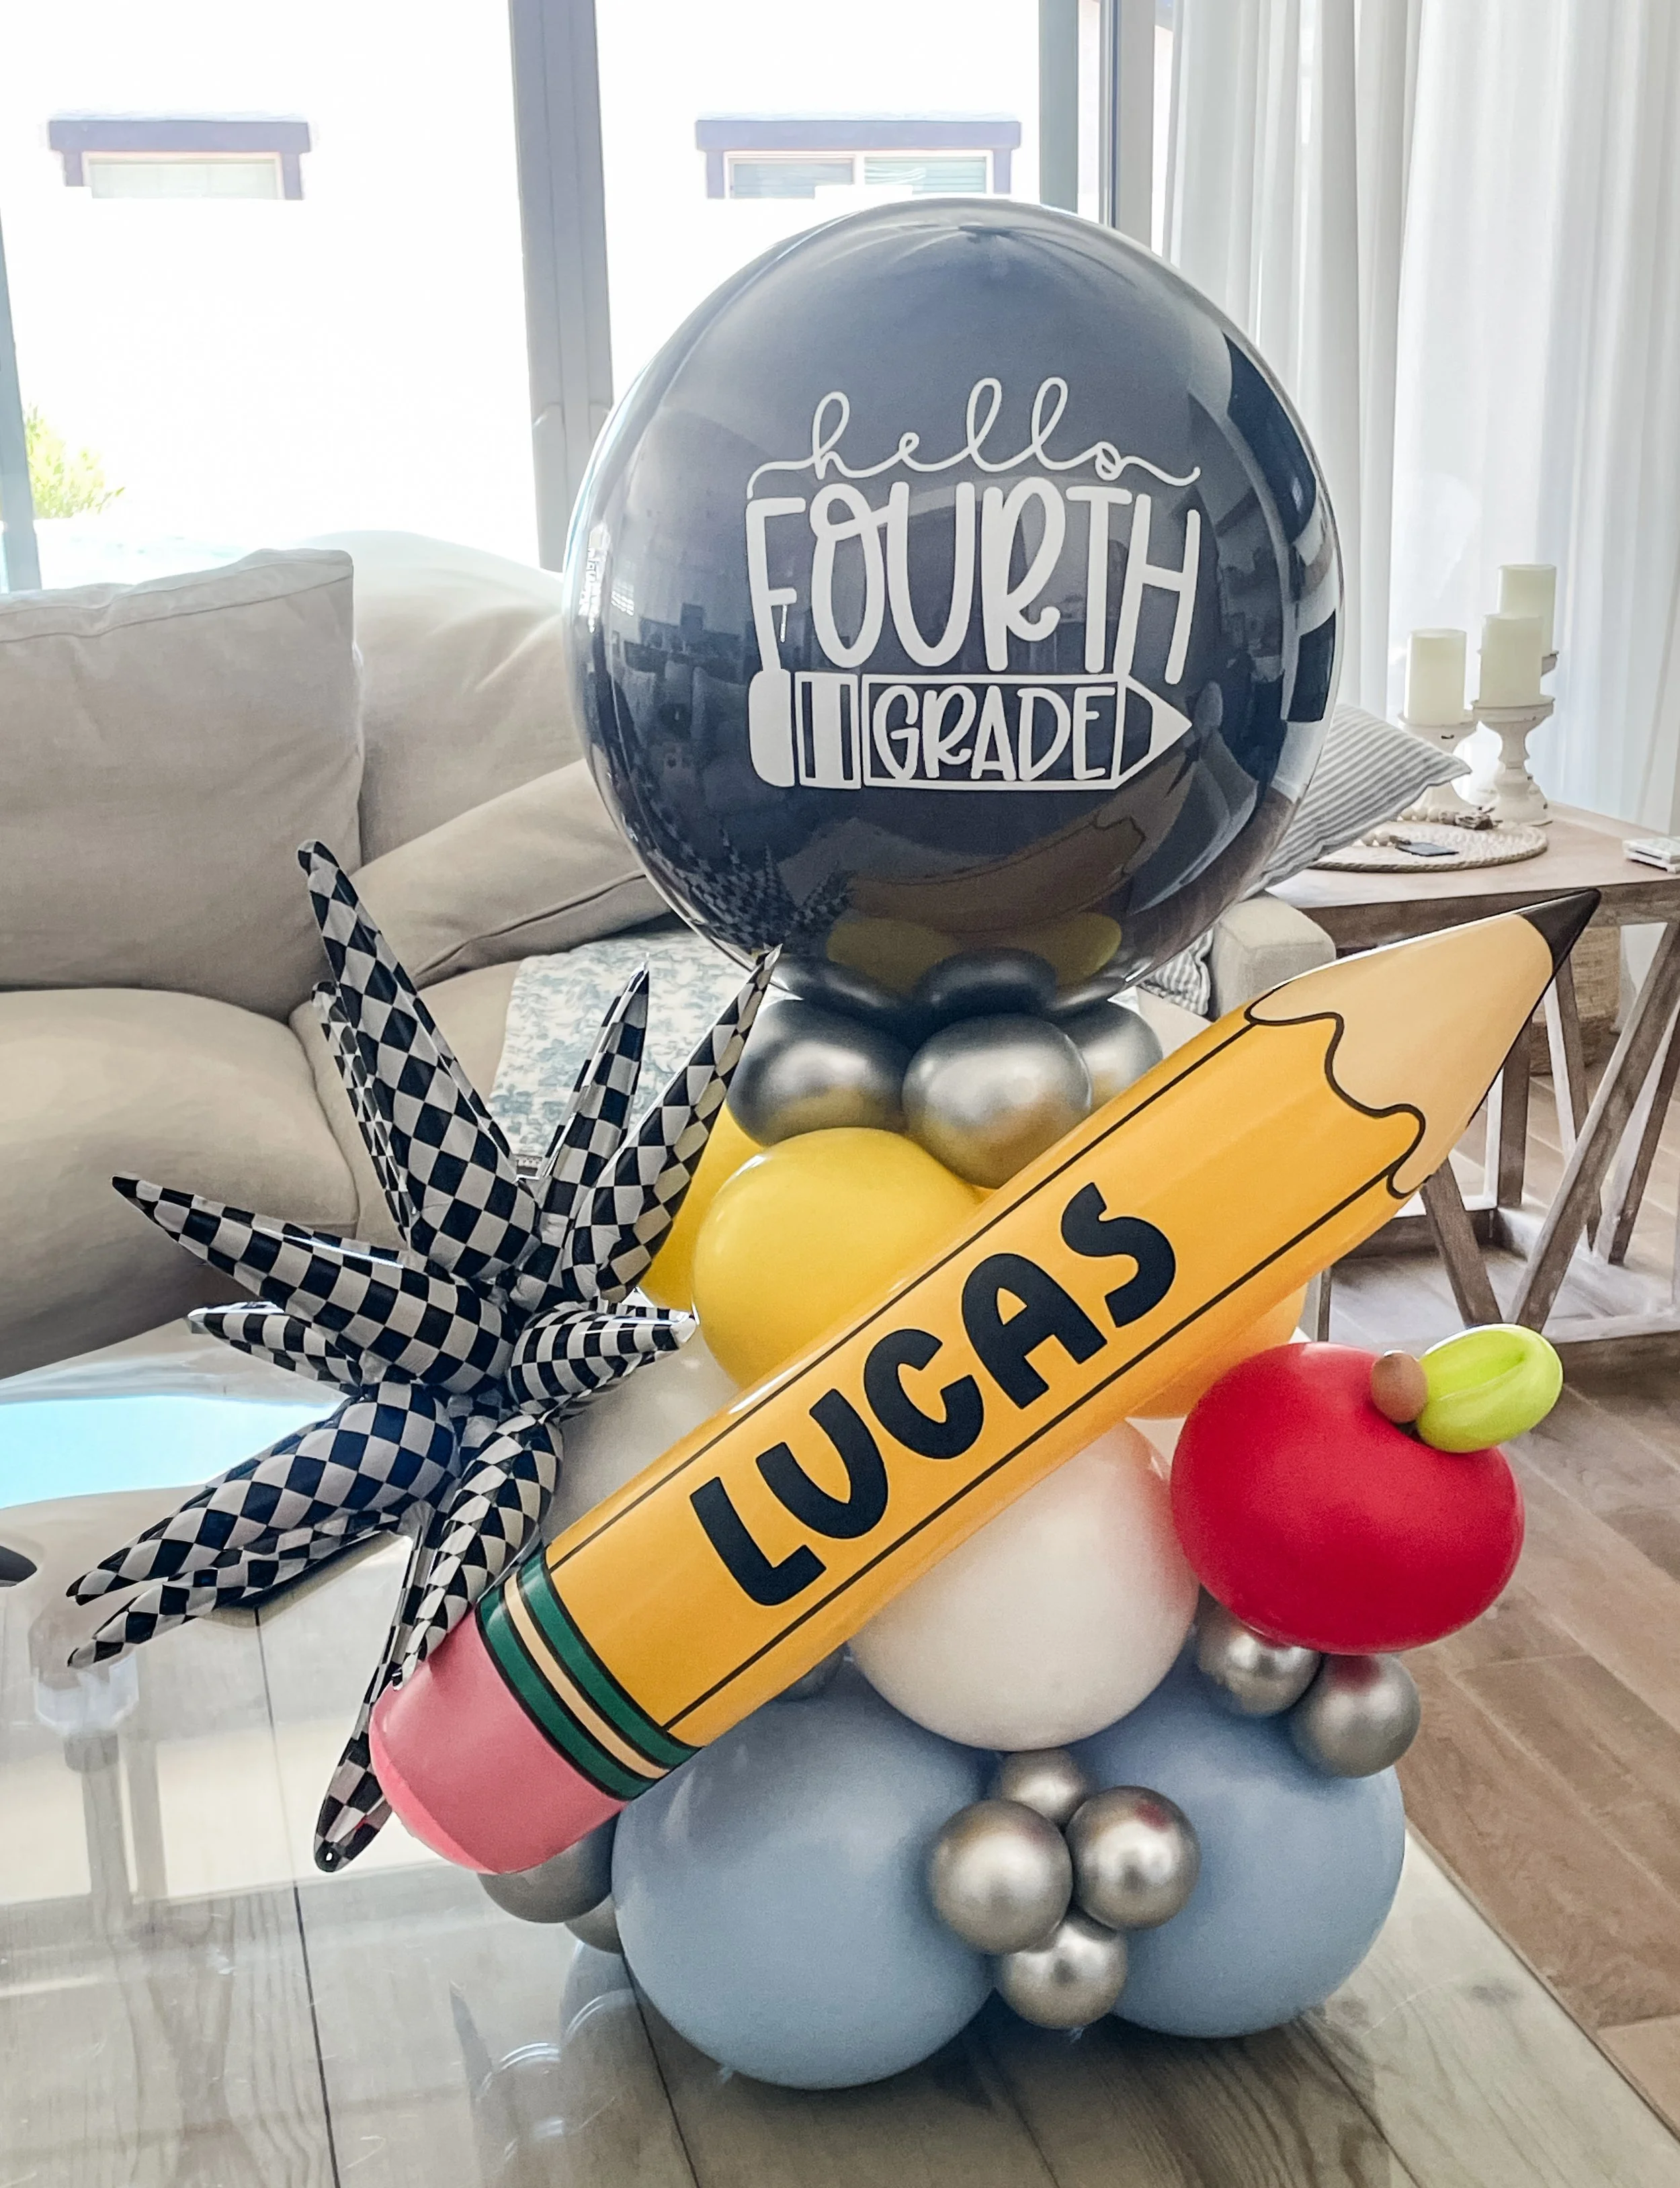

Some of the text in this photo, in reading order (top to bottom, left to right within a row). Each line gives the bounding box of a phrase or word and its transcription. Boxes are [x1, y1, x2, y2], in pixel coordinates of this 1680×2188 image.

[747, 377, 1201, 487] hello
[746, 476, 1201, 685] FOURTH
[873, 685, 1116, 782] GRADE
[689, 1182, 1176, 1606] LUCAS
